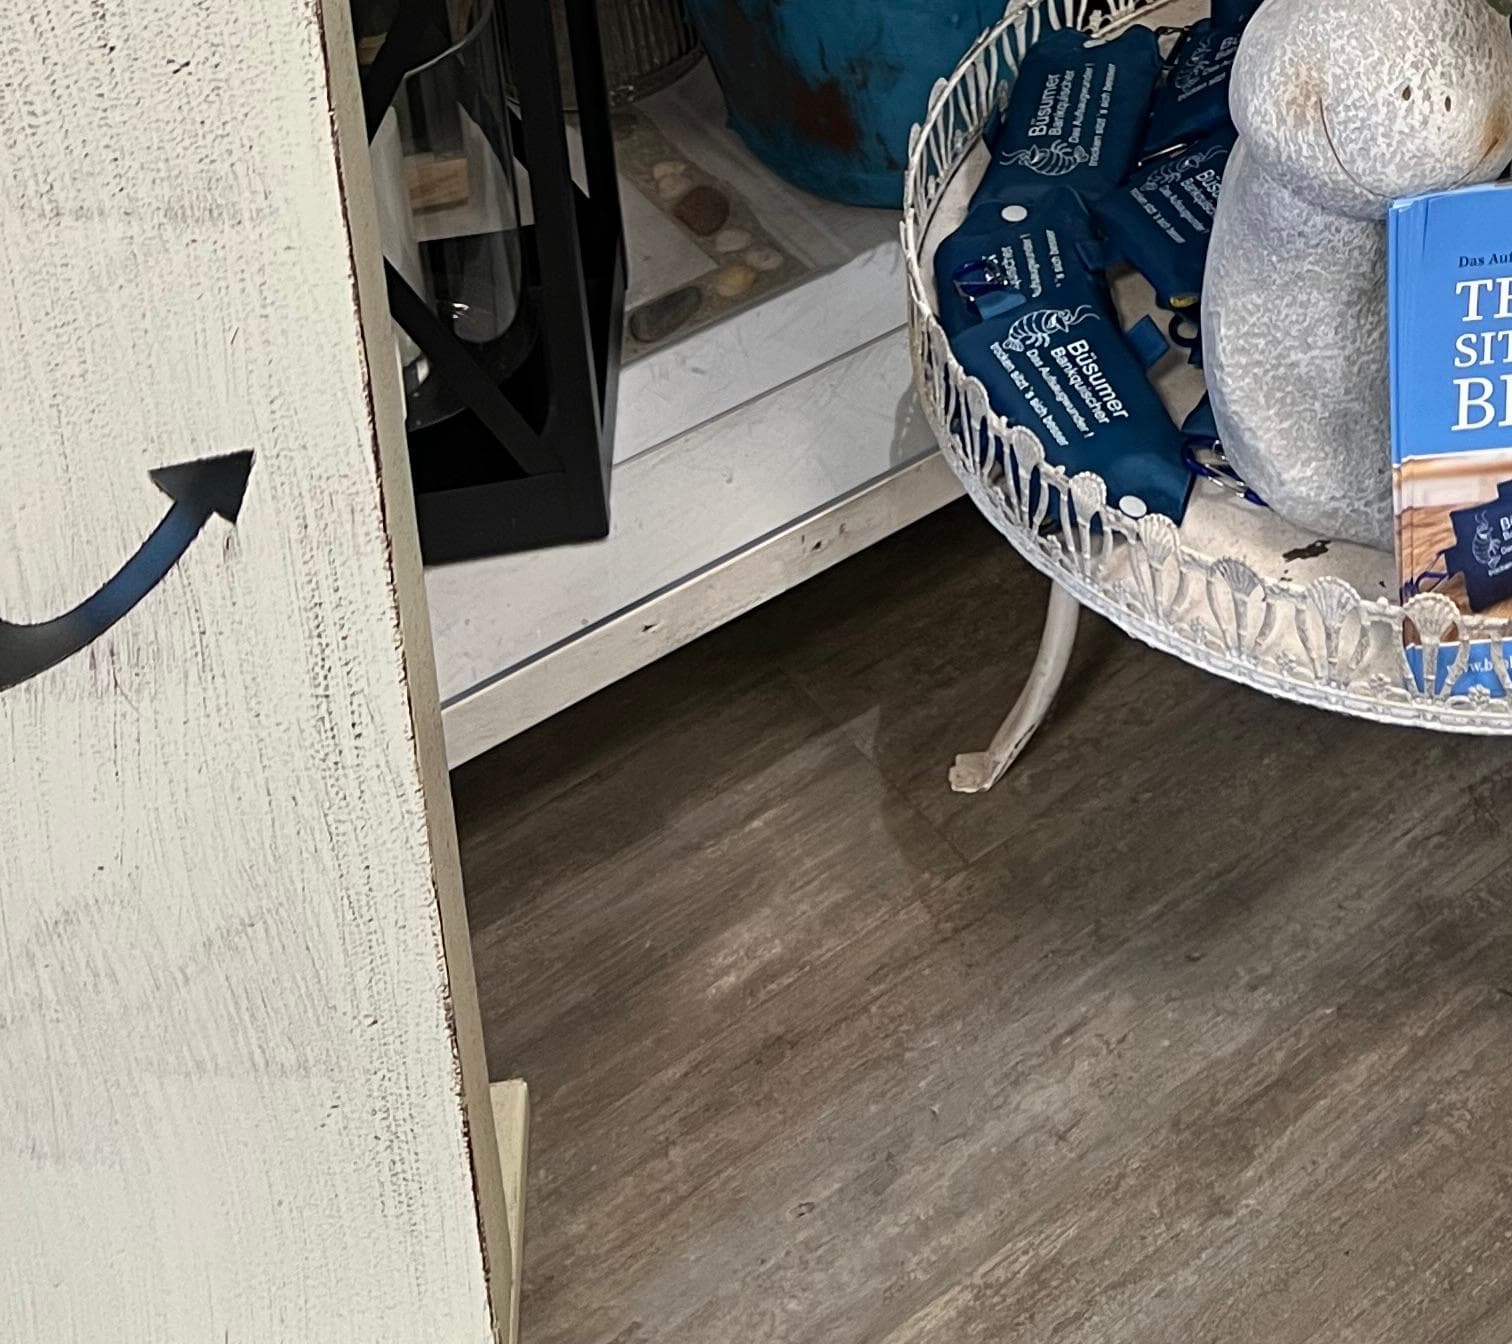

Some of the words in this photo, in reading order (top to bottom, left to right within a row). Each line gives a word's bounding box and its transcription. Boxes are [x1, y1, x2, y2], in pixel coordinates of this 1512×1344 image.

[1028, 74, 1060, 136] Büsumer
[1458, 255, 1486, 269] Das
[1026, 349, 1043, 368] Das
[1050, 346, 1110, 424] Bankquischer
[1066, 339, 1129, 418] Büsumer
